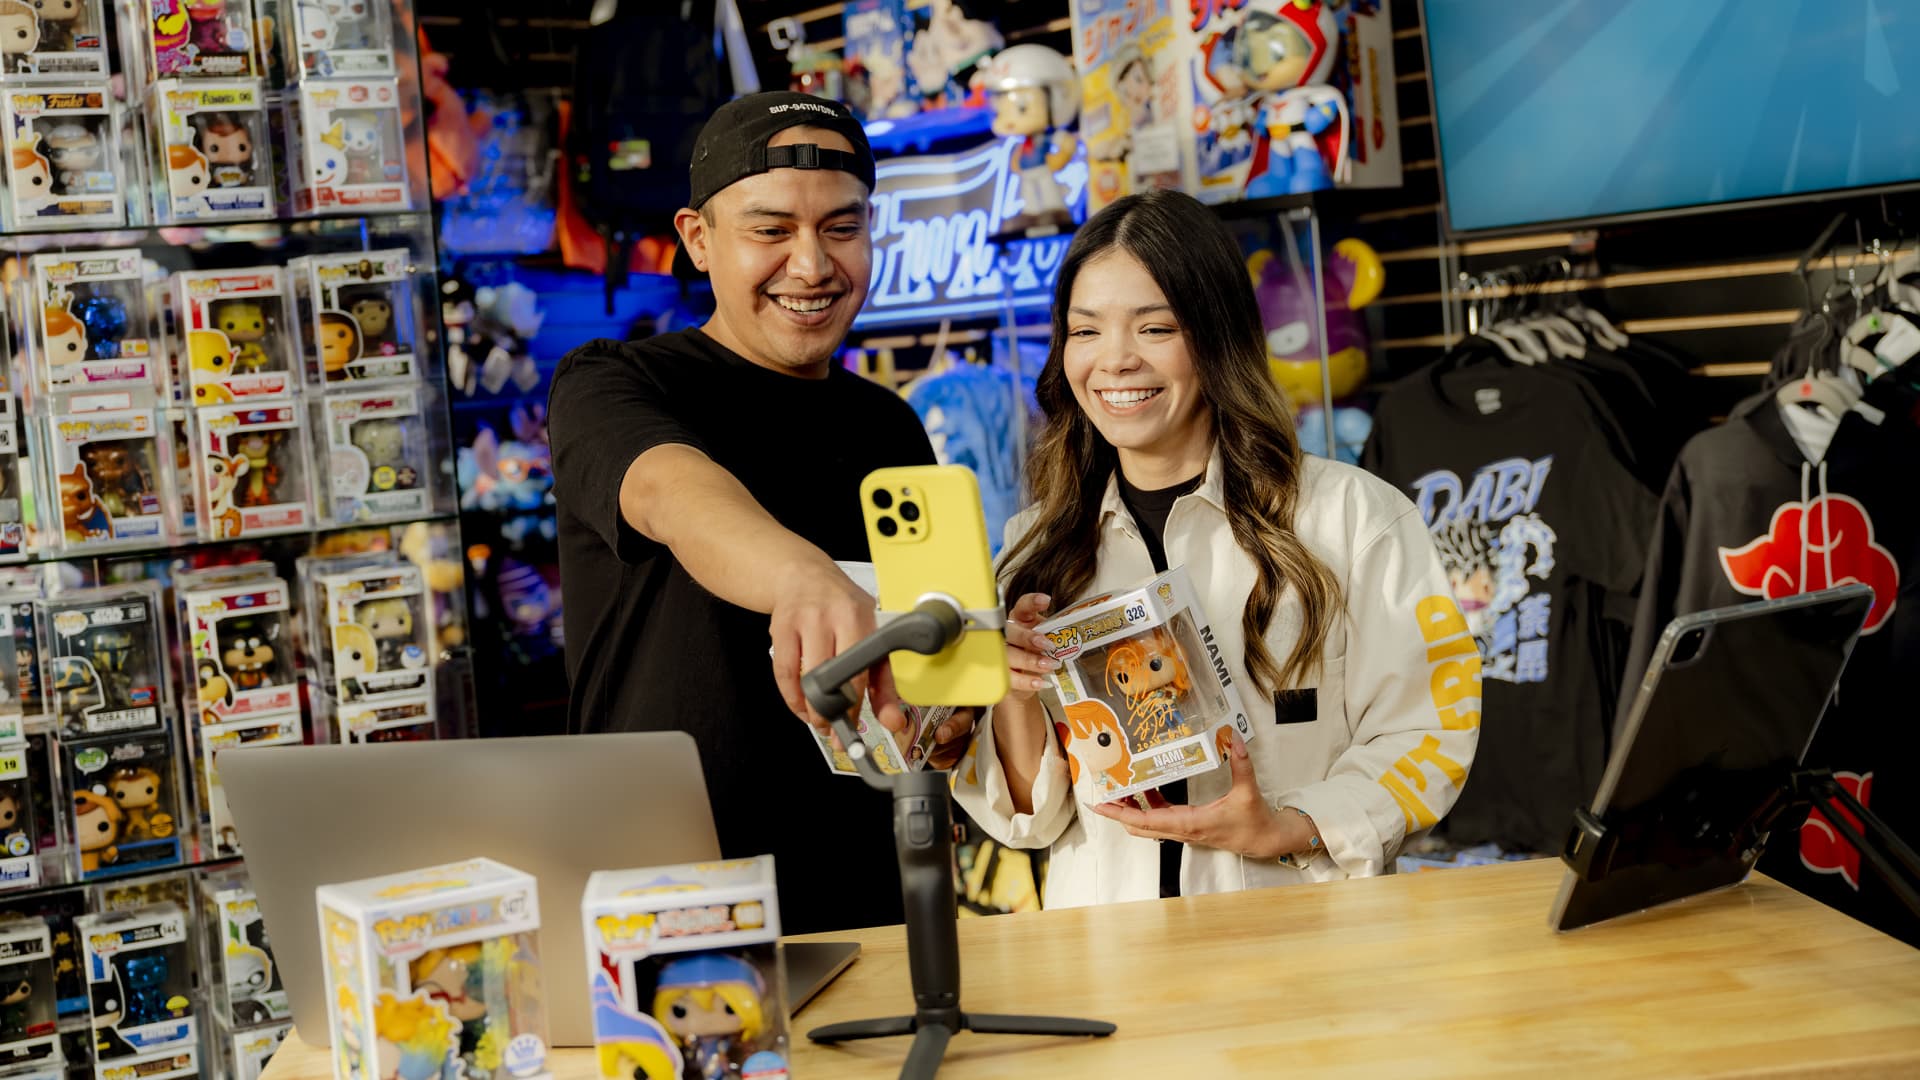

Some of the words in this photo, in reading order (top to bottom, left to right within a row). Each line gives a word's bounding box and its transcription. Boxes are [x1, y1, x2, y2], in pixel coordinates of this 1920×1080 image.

[1409, 454, 1554, 535] DABI
[1126, 605, 1146, 622] 328
[1200, 624, 1232, 688] NAMI
[4, 760, 17, 770] 19
[1152, 748, 1185, 768] NAMI
